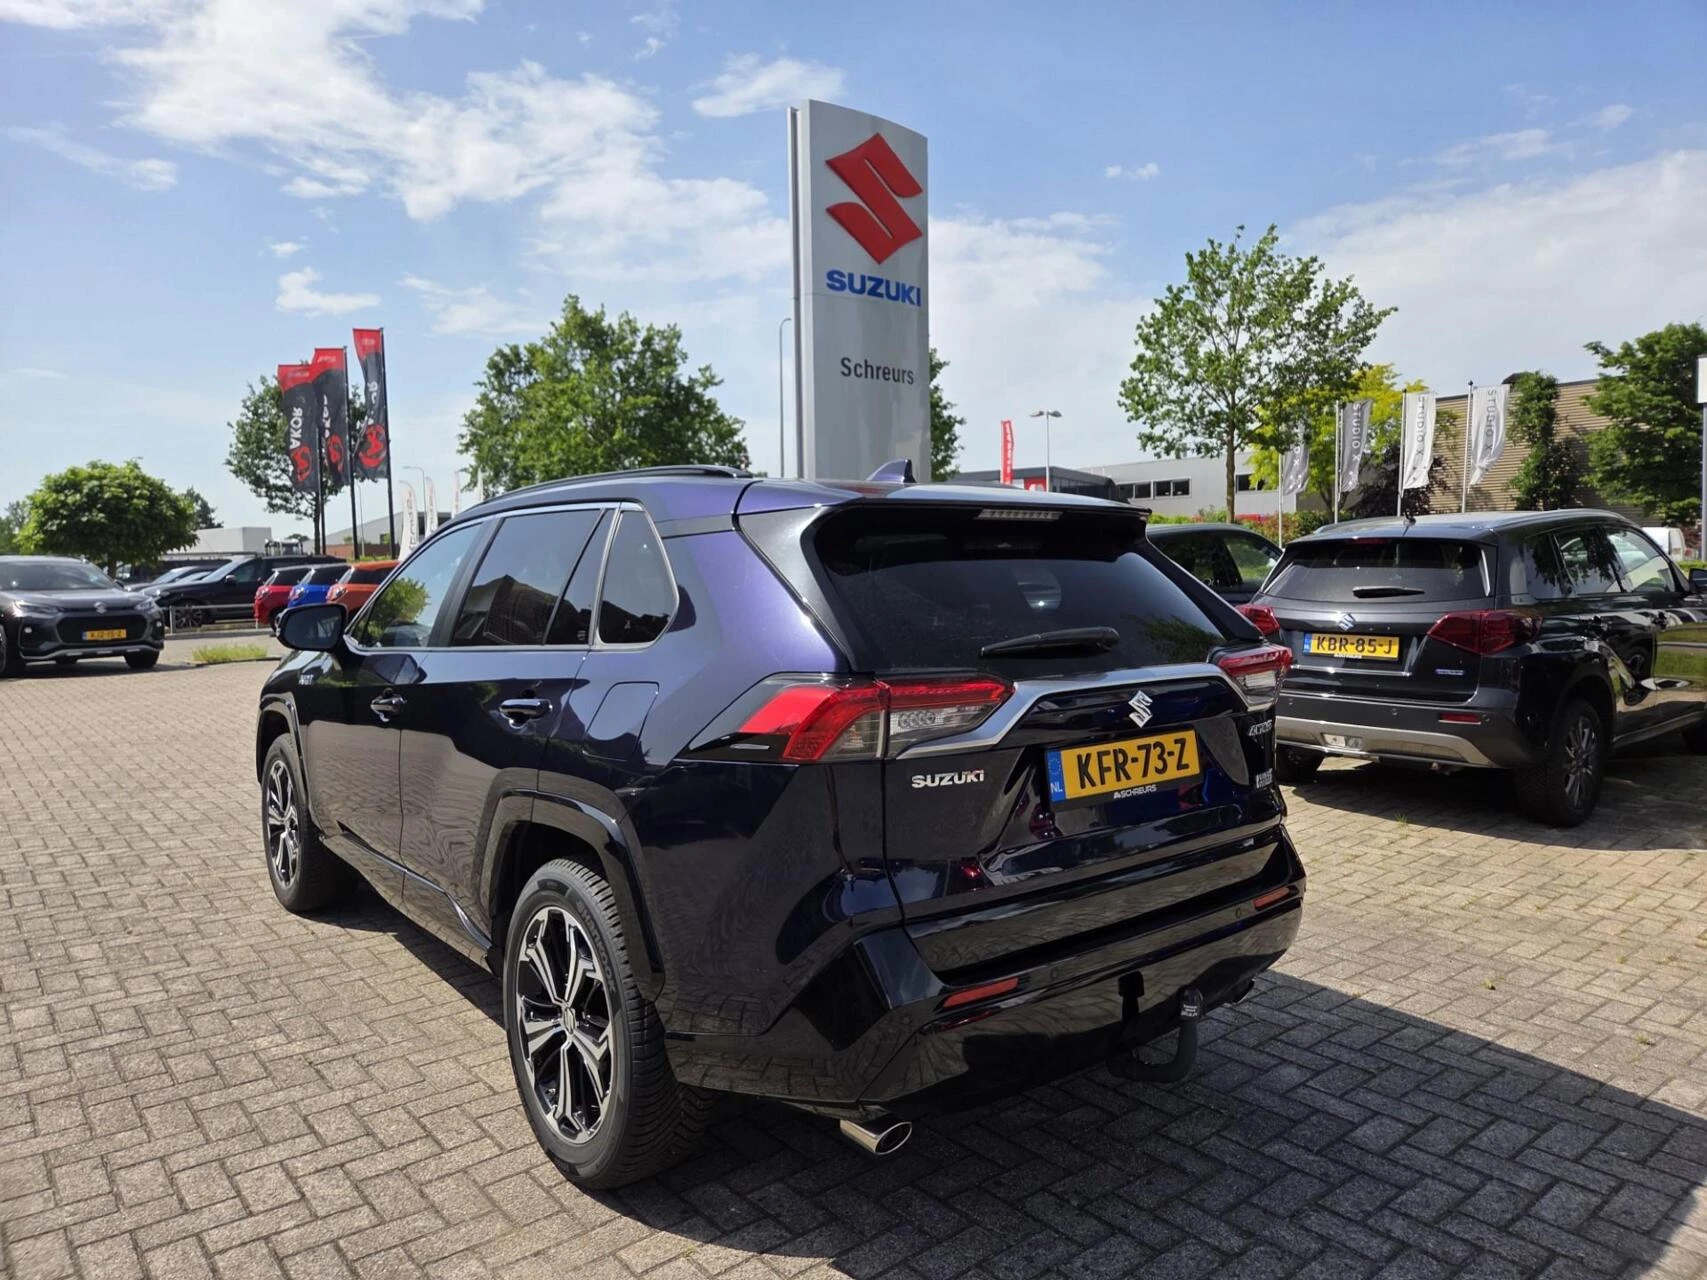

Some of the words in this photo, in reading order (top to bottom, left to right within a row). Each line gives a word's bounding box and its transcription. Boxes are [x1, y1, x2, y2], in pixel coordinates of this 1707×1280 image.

[826, 269, 921, 307] SUZUKI
[840, 357, 915, 385] Schreurs
[1352, 403, 1361, 449] STUDIO
[1486, 389, 1497, 437] STUDIO
[1352, 454, 1361, 462] X
[1317, 636, 1392, 654] KBR-85-J
[1077, 737, 1190, 790] KFR-73-Z
[911, 769, 984, 789] SUZUKI
[1050, 782, 1063, 793] NL
